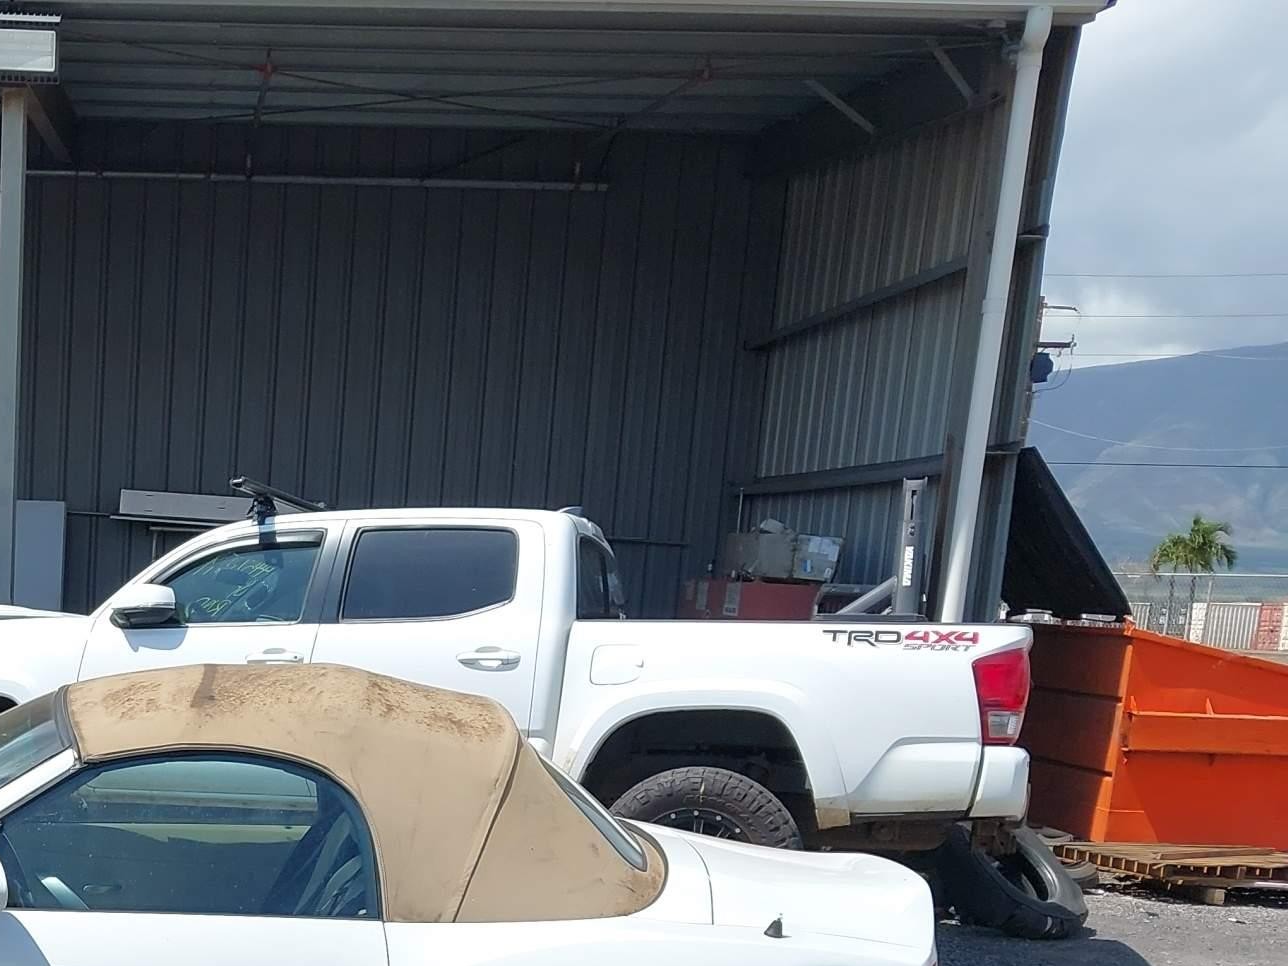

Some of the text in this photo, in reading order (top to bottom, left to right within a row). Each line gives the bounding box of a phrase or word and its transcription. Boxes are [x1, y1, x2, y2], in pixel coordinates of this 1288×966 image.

[902, 546, 914, 586] YAKIMA
[823, 630, 902, 646] TRD
[902, 644, 976, 652] SPORT
